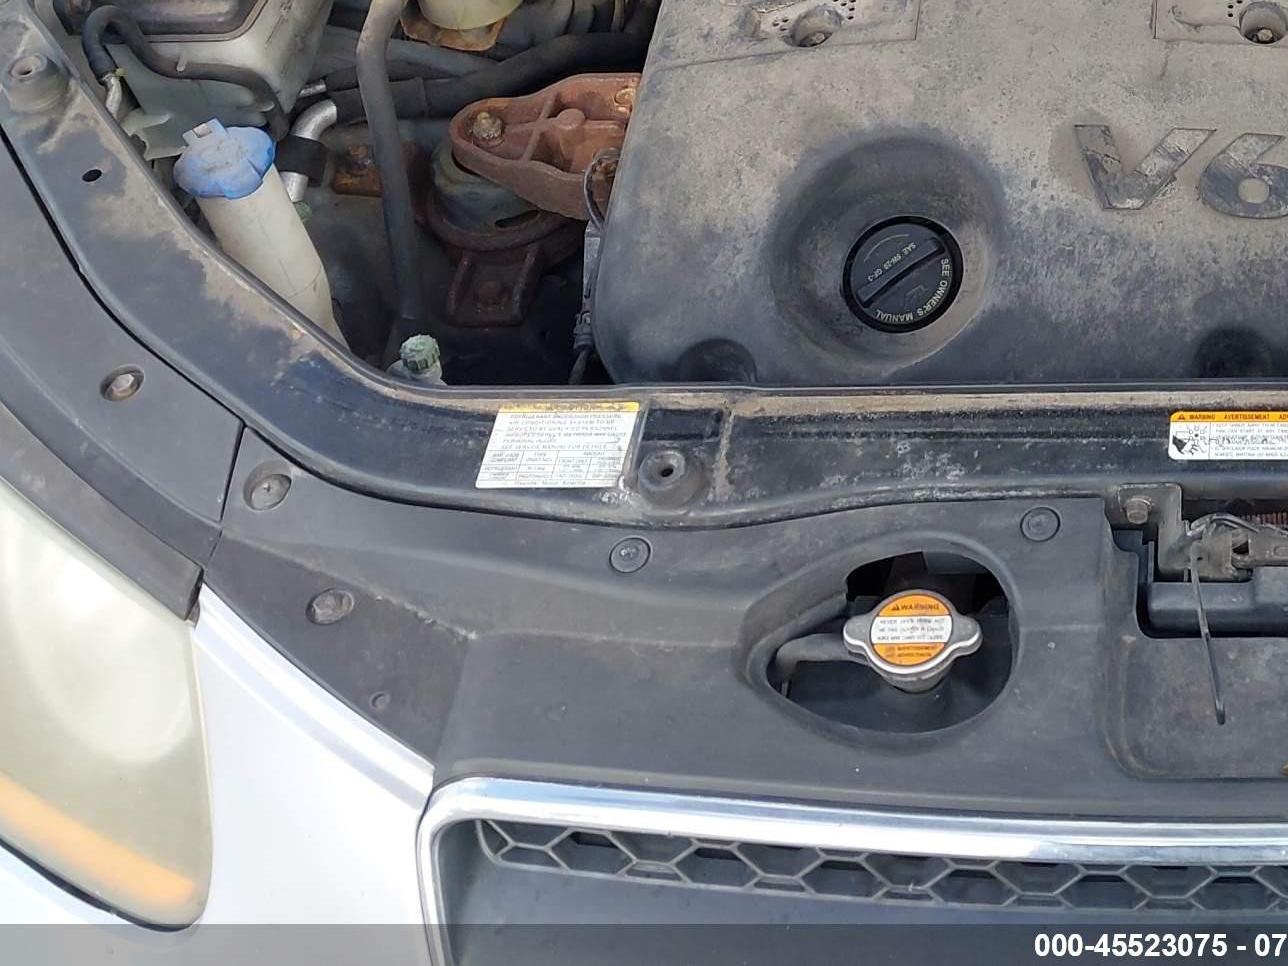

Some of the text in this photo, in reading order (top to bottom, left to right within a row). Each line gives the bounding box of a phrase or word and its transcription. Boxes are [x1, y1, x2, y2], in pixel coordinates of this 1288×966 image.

[902, 242, 917, 255] SAE
[876, 258, 950, 322] SEE OWNER'S MANUAL
[901, 603, 940, 611] WARNING
